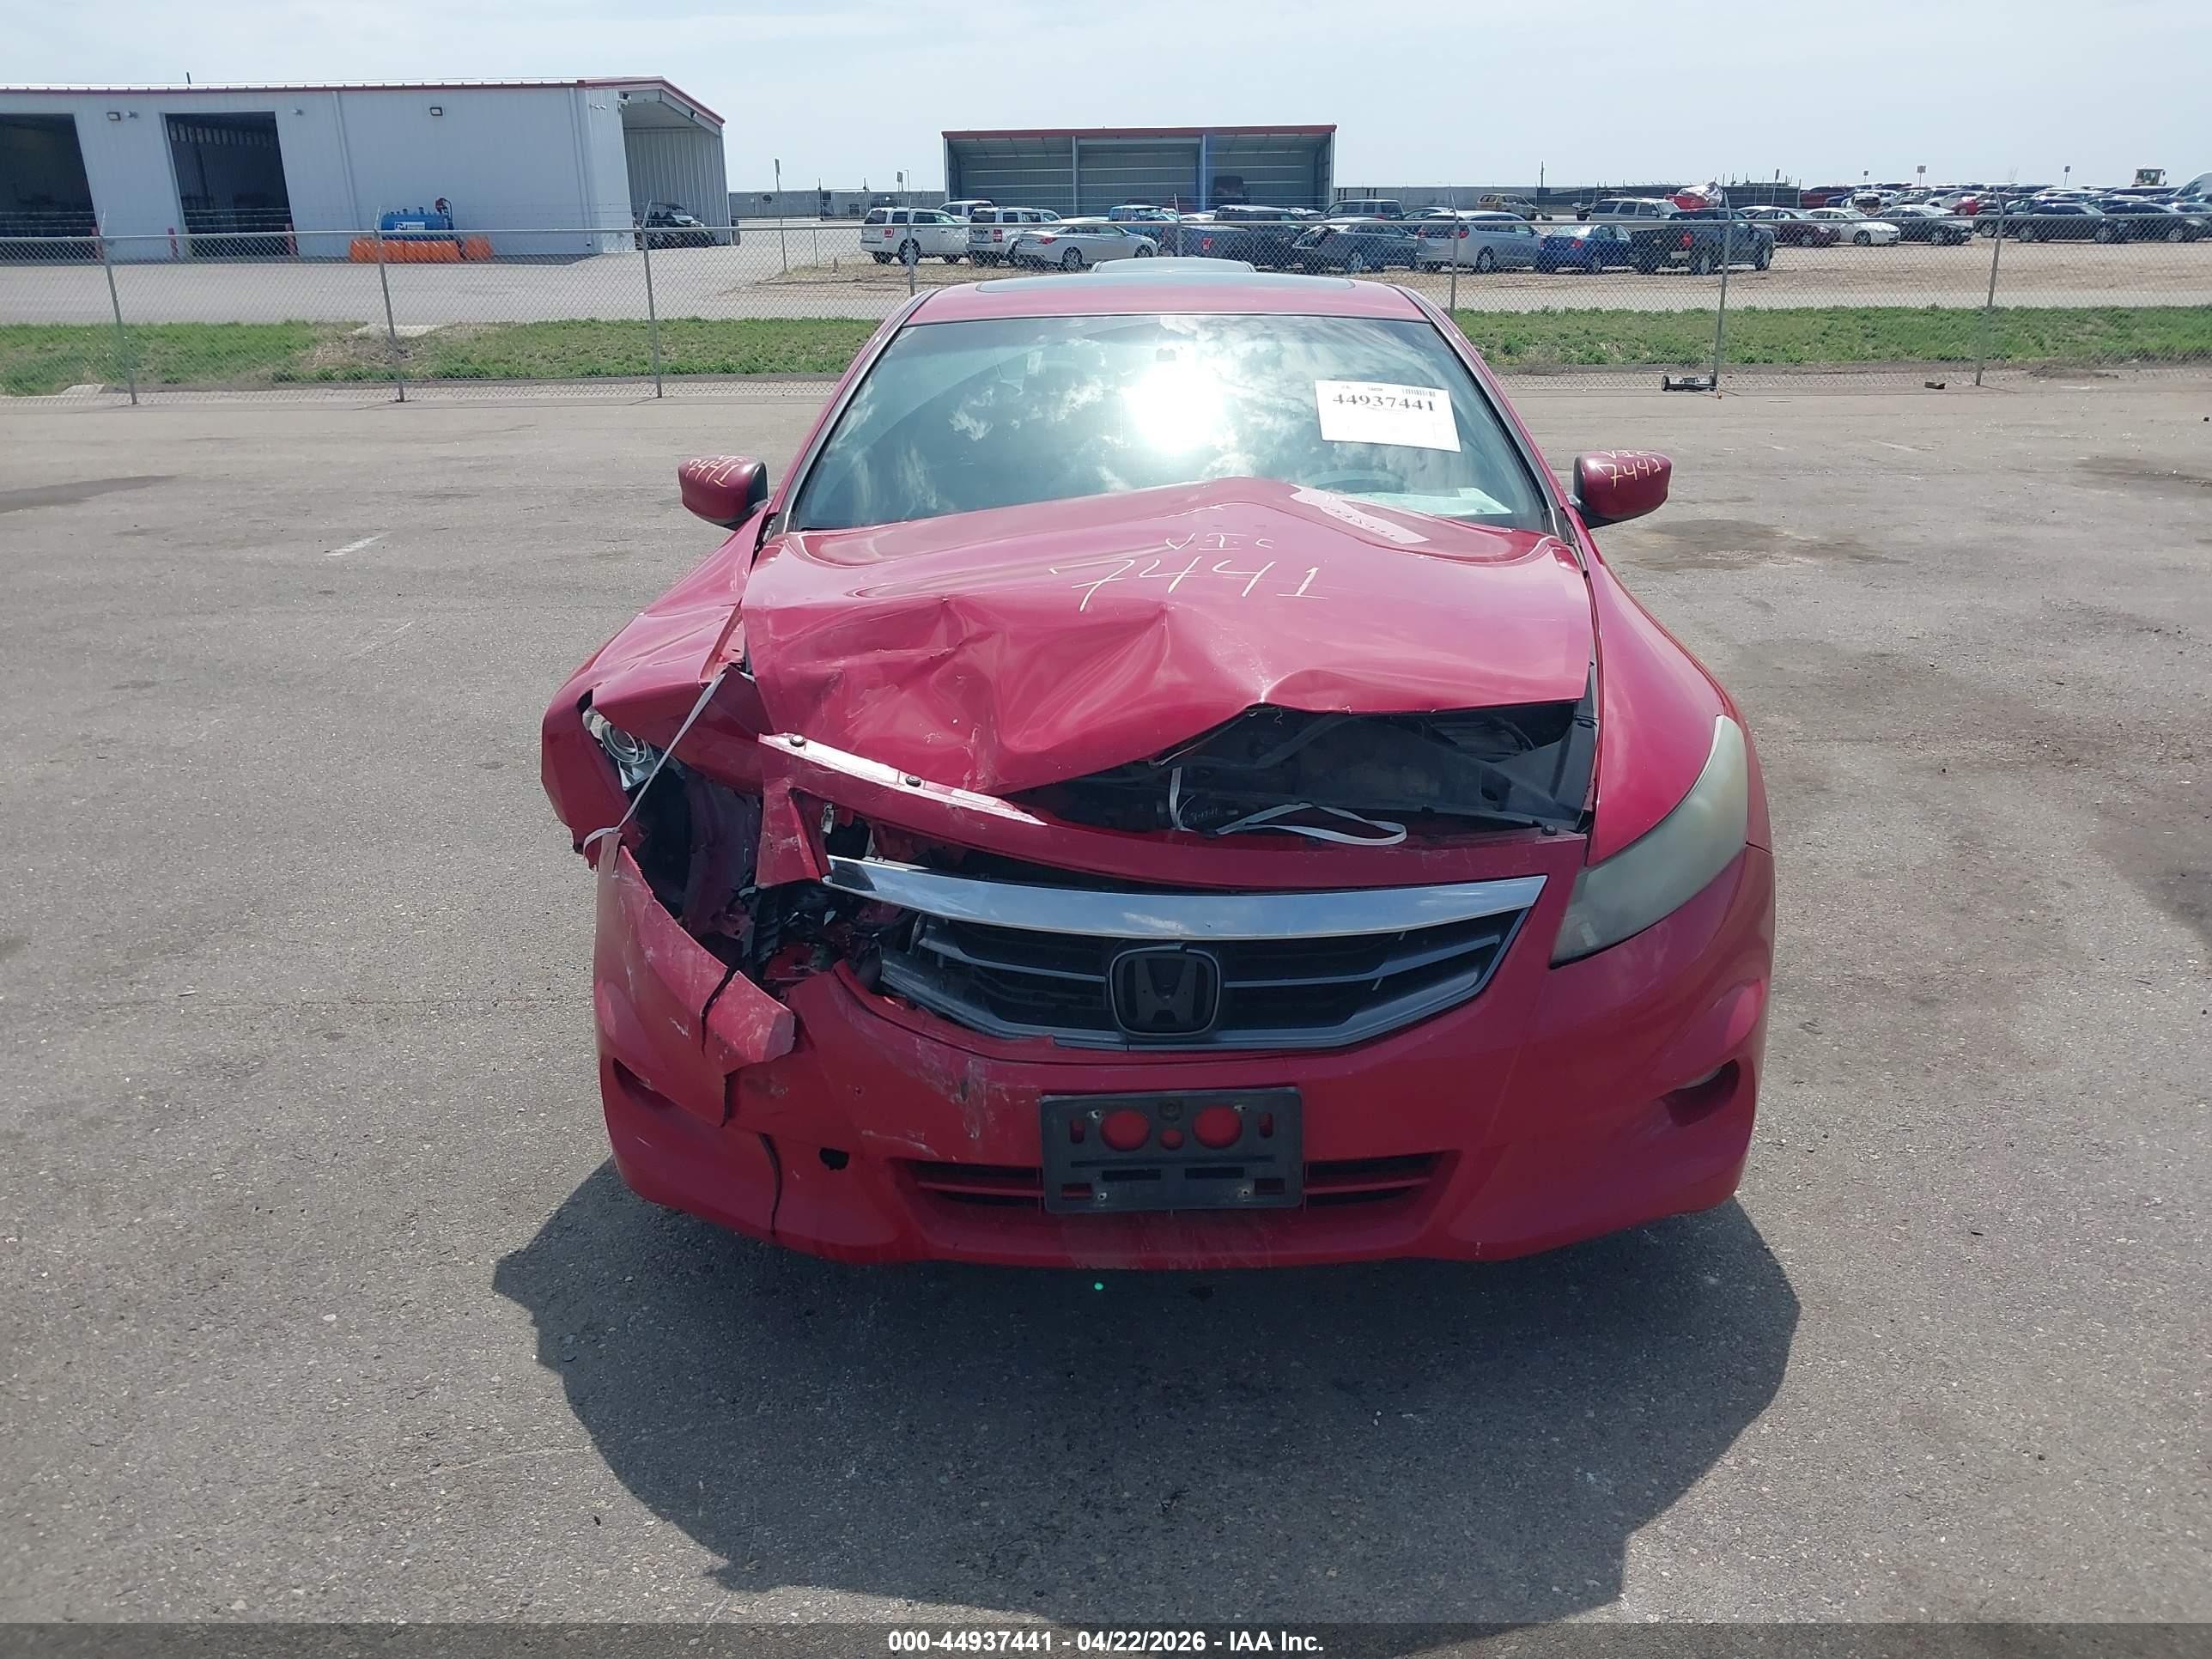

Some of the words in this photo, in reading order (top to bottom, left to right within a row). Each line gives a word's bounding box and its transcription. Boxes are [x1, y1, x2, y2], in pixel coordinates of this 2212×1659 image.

[1333, 392, 1436, 412] 44937441
[685, 458, 740, 488] 7441
[1596, 457, 1663, 489] 7441
[1048, 555, 1329, 612] 7441
